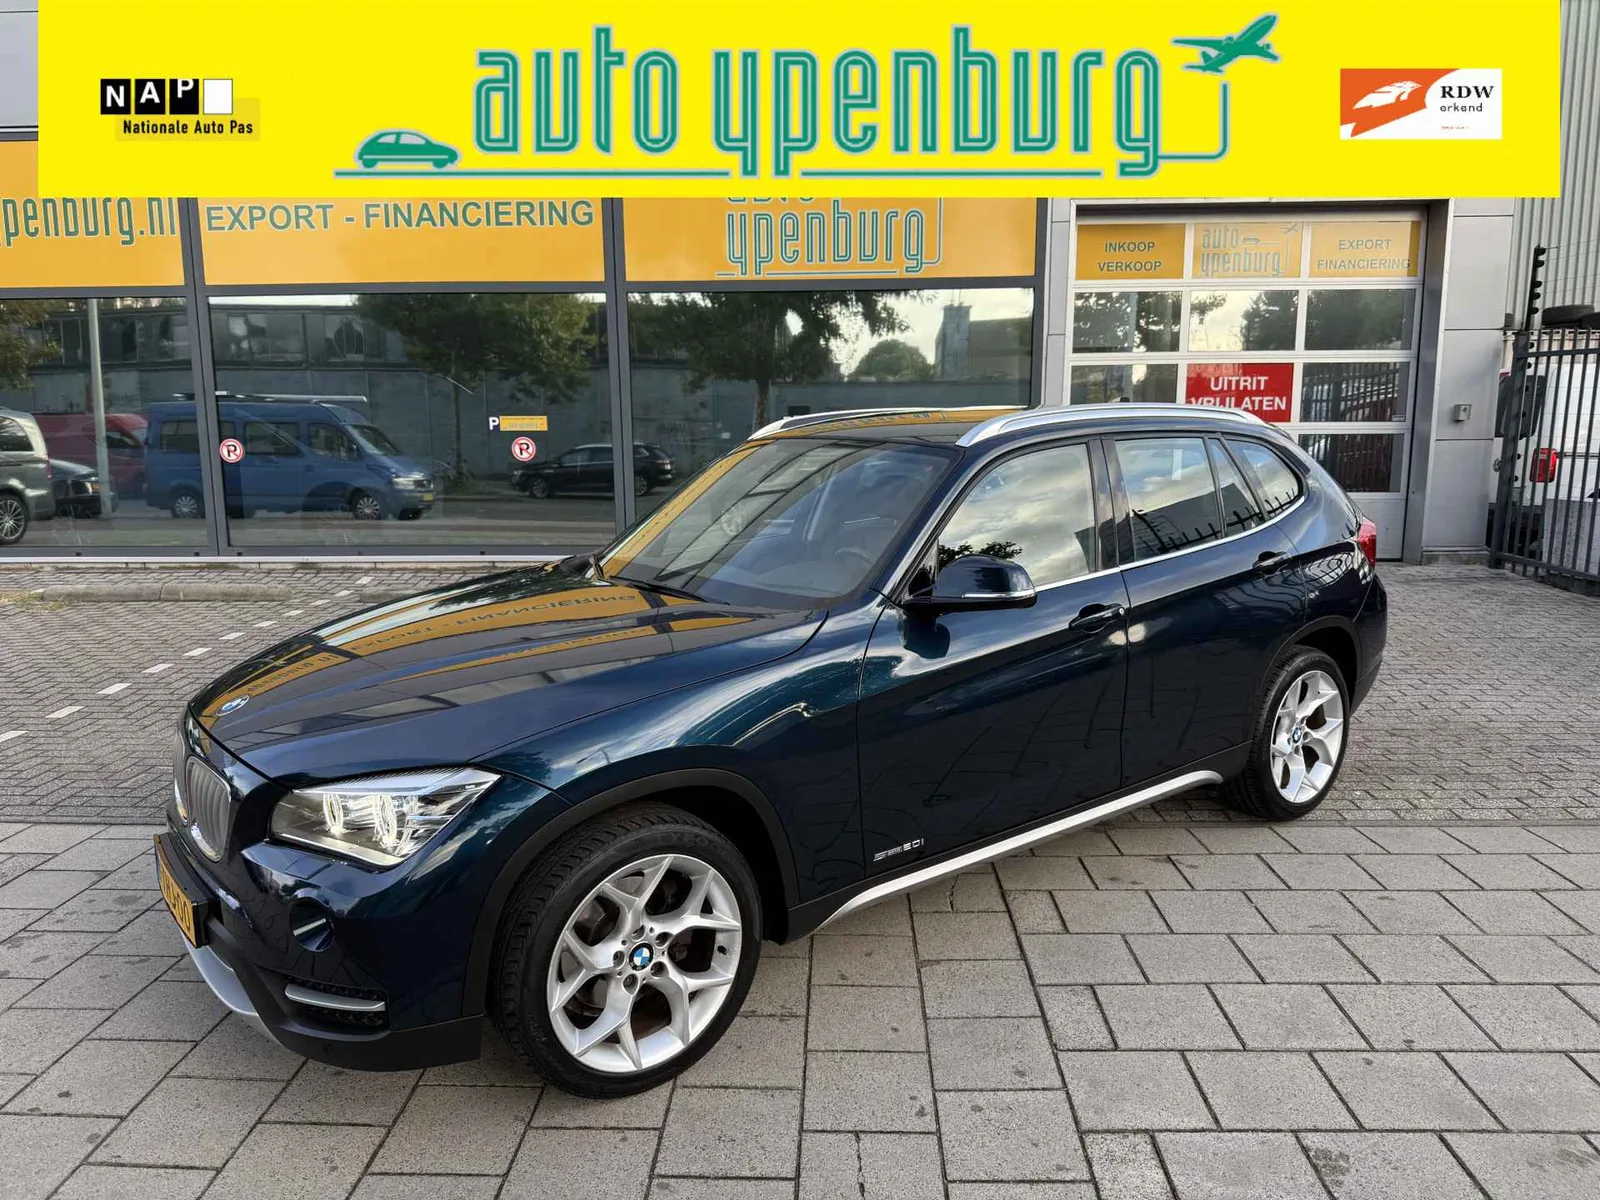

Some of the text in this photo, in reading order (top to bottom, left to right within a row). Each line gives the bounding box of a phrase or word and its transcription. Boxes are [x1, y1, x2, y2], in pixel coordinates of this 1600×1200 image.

[0, 197, 177, 247] penburg.nl
[206, 204, 334, 231] EXPORT
[364, 200, 594, 229] FINANCIERING
[726, 199, 925, 276] ypenburg
[1338, 239, 1391, 250] EXPORT
[1104, 241, 1155, 253] INKOOP
[1098, 261, 1162, 272] VERKOOP
[1317, 258, 1410, 270] FINANCIERING
[1210, 376, 1268, 391] UITRIT
[489, 416, 500, 430] P
